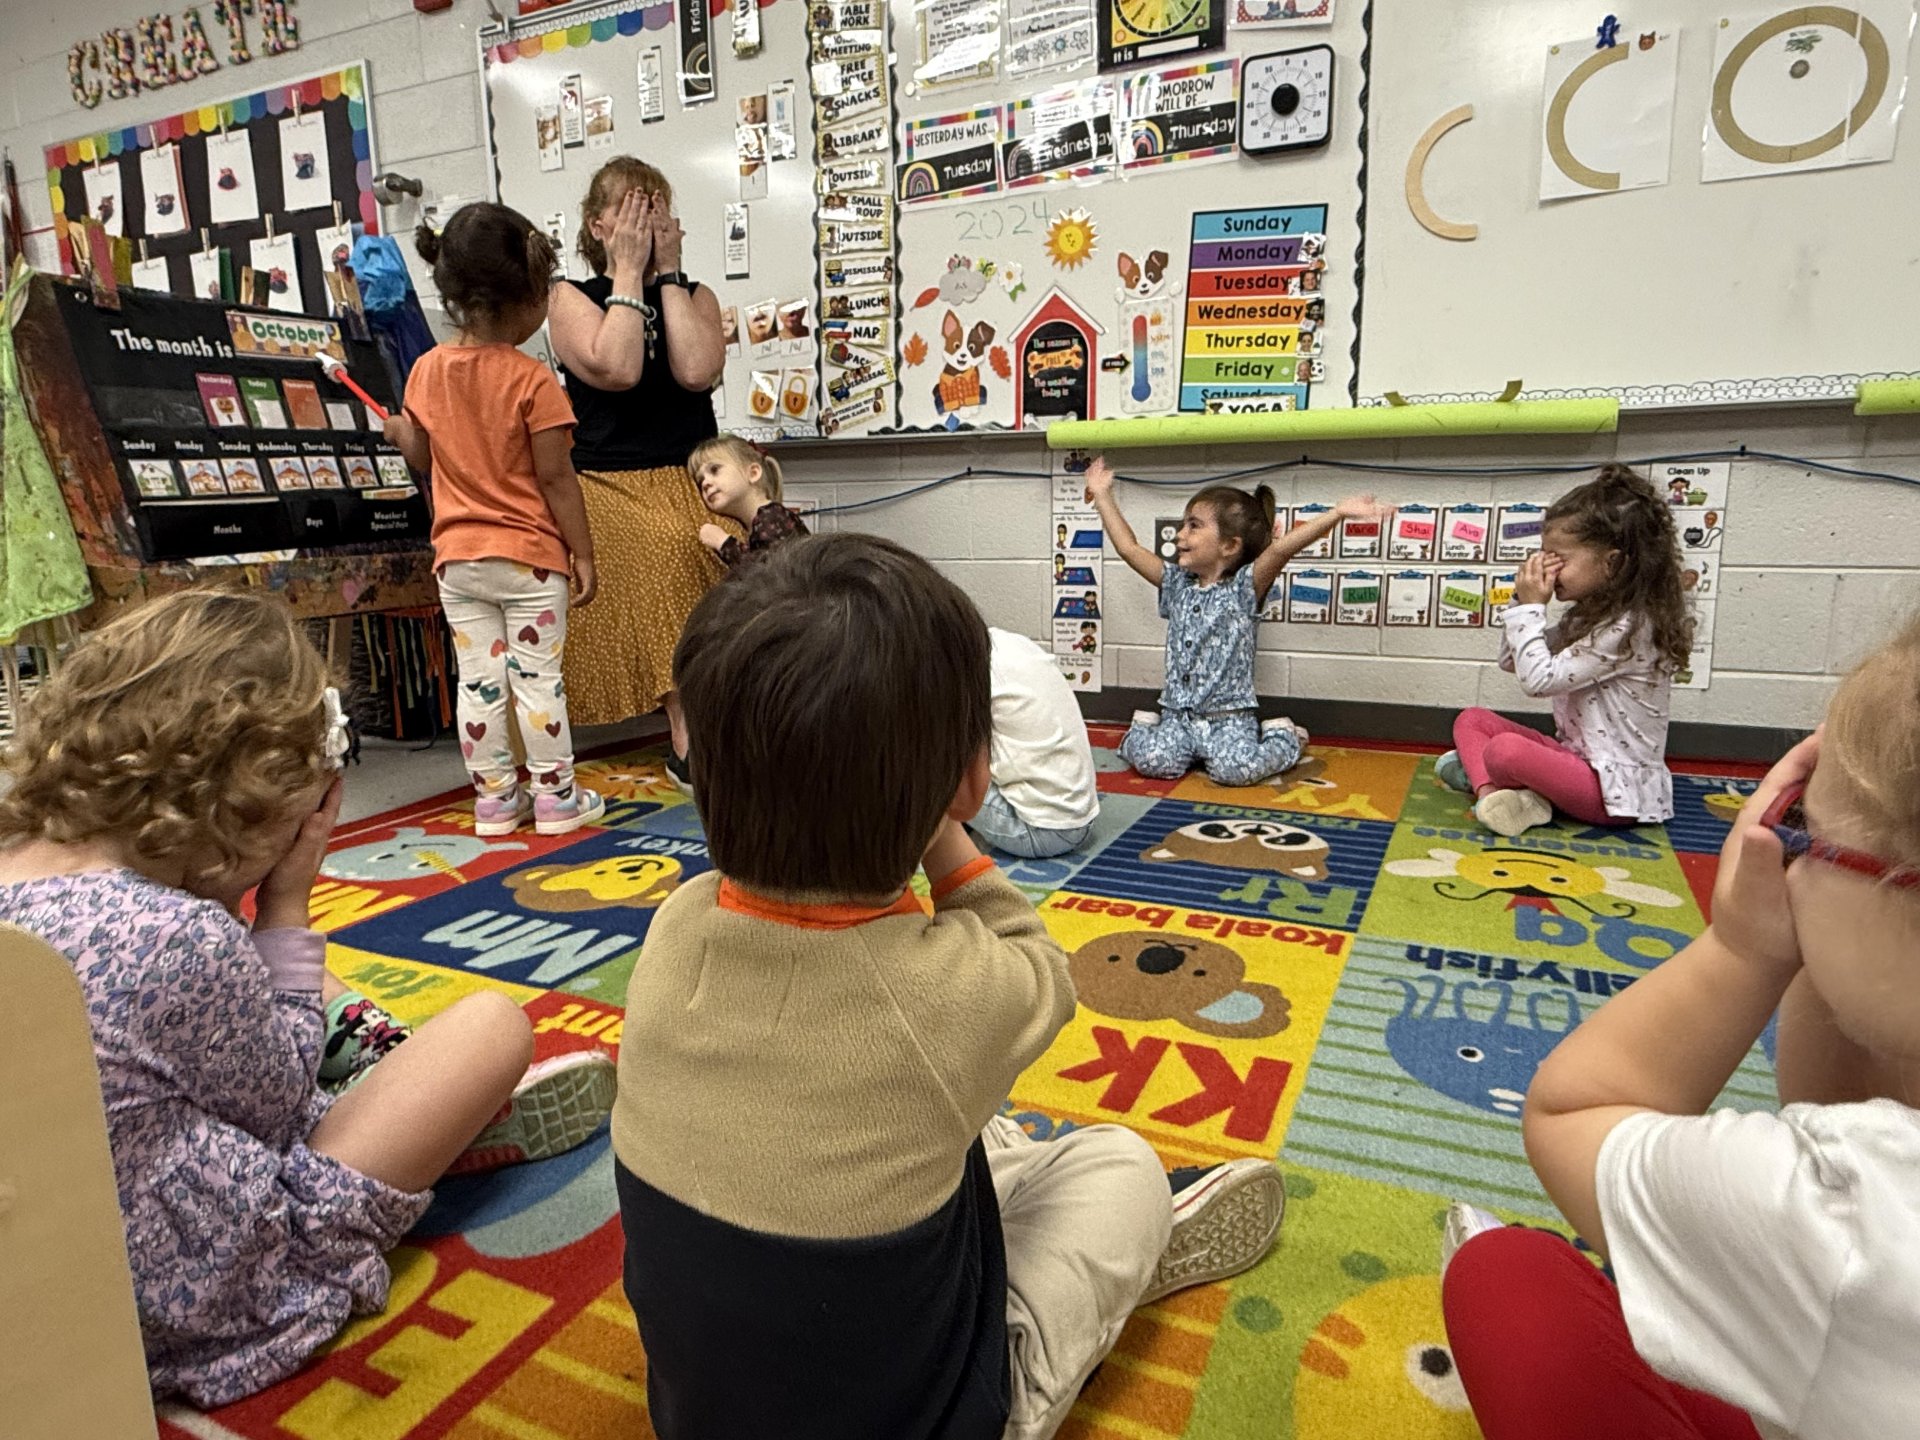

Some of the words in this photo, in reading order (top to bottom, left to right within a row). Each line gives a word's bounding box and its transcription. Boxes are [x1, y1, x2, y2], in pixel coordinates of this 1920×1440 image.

[690, 0, 701, 33] Frida
[840, 4, 870, 16] TABLE
[840, 15, 870, 27] WORK
[830, 43, 872, 56] MEETING
[1113, 51, 1122, 63] It
[1124, 48, 1133, 61] is
[841, 59, 866, 75] FREE
[1265, 66, 1273, 74] 55
[1315, 71, 1323, 79] 10
[1156, 76, 1215, 98] OMORROW
[1319, 90, 1327, 98] 15
[834, 86, 880, 110] SNACKS
[1155, 98, 1184, 113] WILL
[833, 127, 882, 148] LIBRARY
[914, 126, 965, 147] YESTERDAY
[1170, 117, 1236, 141] Thursday
[1047, 131, 1113, 161] Wednesay
[832, 169, 875, 182] OUTSID
[944, 158, 992, 180] Tuesday
[851, 196, 883, 207] SMALL
[853, 207, 883, 217] ROUP
[955, 198, 1051, 241] 2024
[1223, 215, 1292, 233] Sunday
[1217, 244, 1293, 261] Monday
[1214, 274, 1291, 291] Tuesday
[850, 297, 885, 311] LUNCH
[1197, 303, 1304, 320] Wednesday
[110, 328, 153, 351] The
[156, 336, 213, 358] month
[215, 340, 233, 358] is
[252, 322, 327, 349] October
[853, 327, 880, 339] NAP
[1205, 332, 1290, 350] Thursday
[1215, 362, 1274, 379] Friday
[199, 375, 233, 385] Yesterday
[248, 379, 267, 388] Today
[1201, 388, 1290, 401] Saturda
[1228, 402, 1283, 414] YOGA
[122, 440, 156, 452] Sunday
[175, 440, 203, 452] Monday
[218, 441, 251, 452] Tuesday
[256, 441, 297, 452] Wednesday
[302, 442, 333, 452] Thursday
[345, 443, 365, 453] Friday
[376, 444, 400, 452] Satur
[1667, 467, 1694, 475] Clean
[1697, 467, 1710, 476] Up
[213, 524, 242, 534] Months
[306, 518, 323, 528] Days
[1459, 526, 1480, 537] Ava
[1446, 590, 1479, 606] Hazel
[1493, 590, 1510, 599] Ma
[1193, 803, 1362, 832] raccoon
[1412, 826, 1496, 847] bee
[614, 835, 709, 858] nkey
[1509, 835, 1662, 861] queen
[1218, 877, 1360, 928] Rr
[1050, 896, 1174, 930] bear
[1186, 912, 1346, 956] koala
[422, 909, 639, 985] Mm
[1406, 944, 1640, 997] ellyfish
[344, 962, 440, 1000] fox
[1057, 1026, 1293, 1142] Kk
